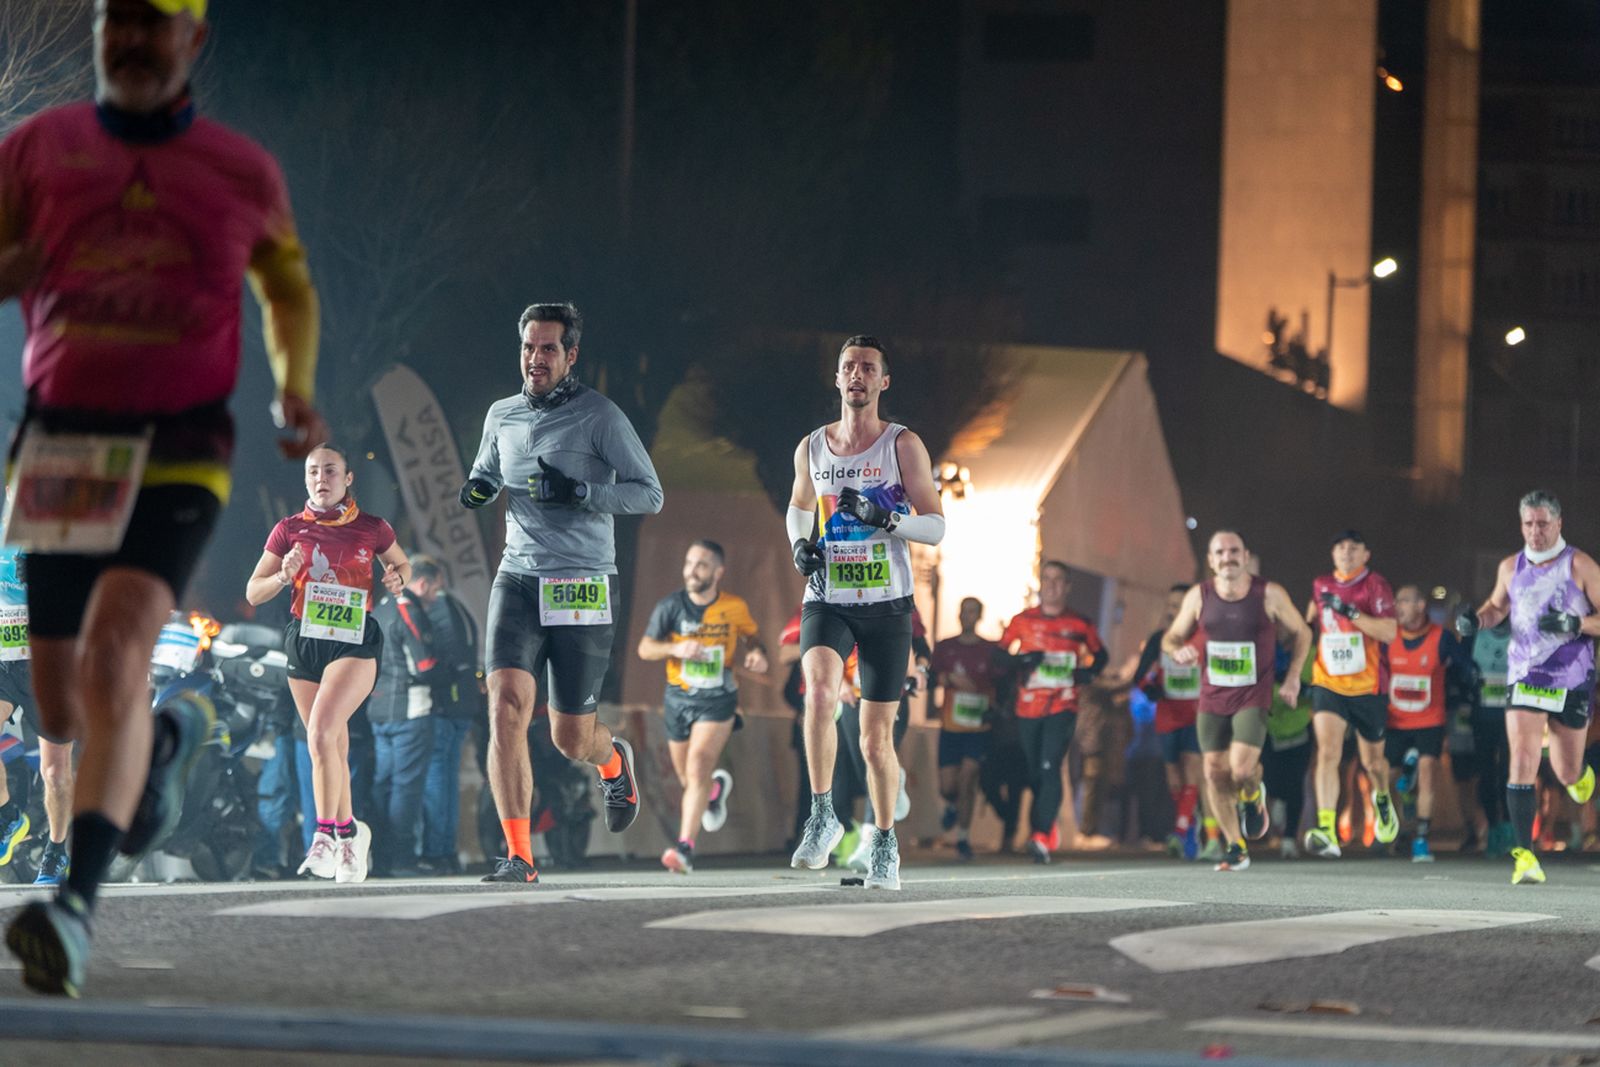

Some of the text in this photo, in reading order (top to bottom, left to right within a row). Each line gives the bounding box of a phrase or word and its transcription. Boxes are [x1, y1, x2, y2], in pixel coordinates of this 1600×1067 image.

[814, 461, 881, 486] calderón
[418, 403, 484, 579] JAPEMASA
[836, 562, 883, 582] 13312
[553, 584, 599, 603] 5649
[316, 603, 353, 623] 2124
[0, 625, 28, 642] 893
